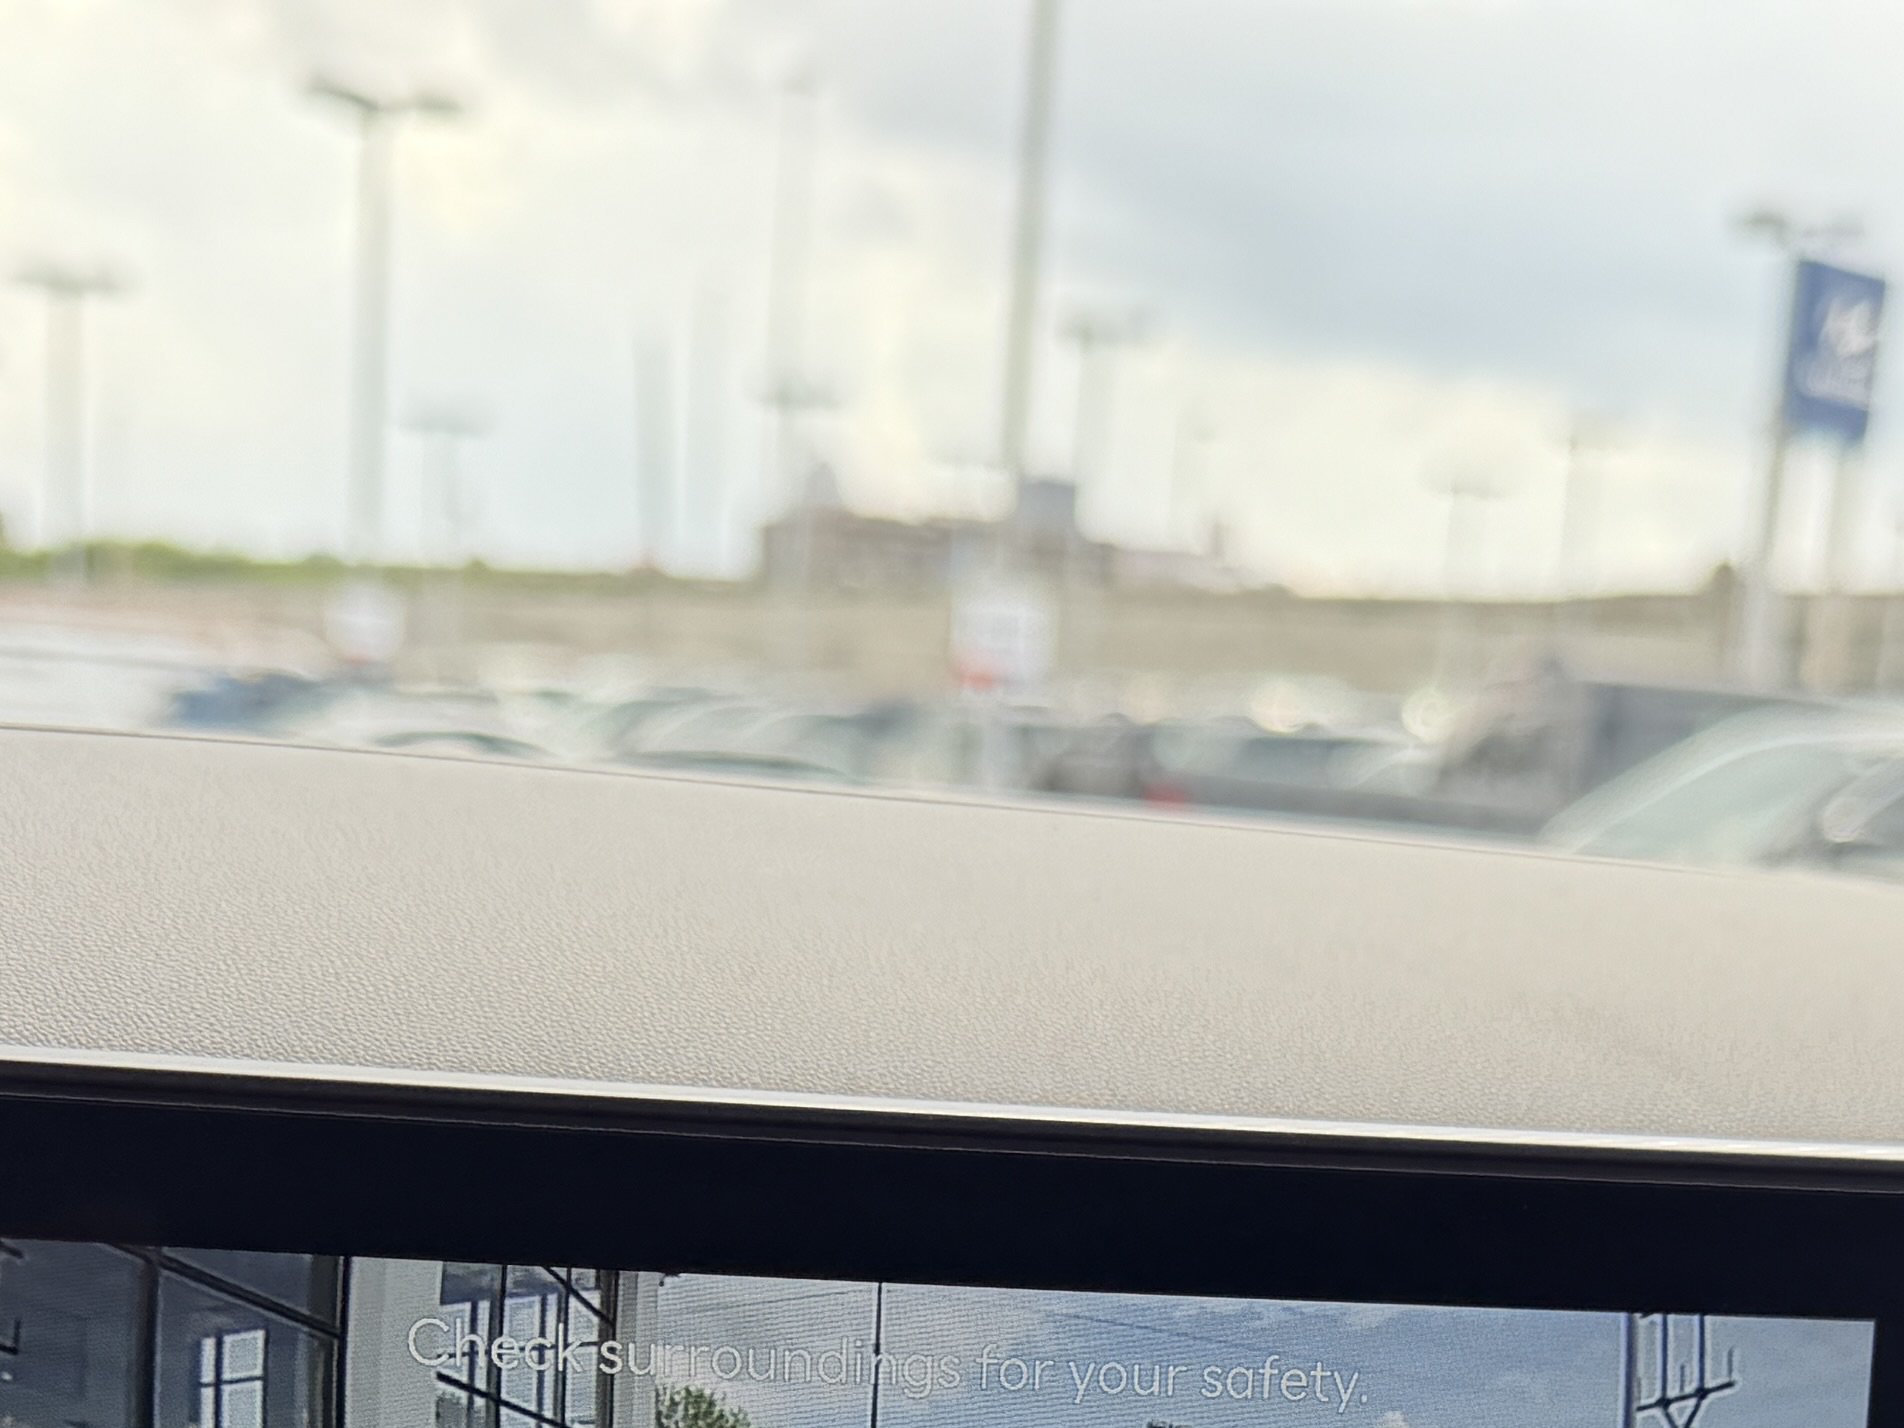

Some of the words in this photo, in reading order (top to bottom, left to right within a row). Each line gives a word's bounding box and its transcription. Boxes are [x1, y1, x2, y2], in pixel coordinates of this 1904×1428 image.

[407, 1318, 582, 1373] Check
[598, 1337, 962, 1399] surroundings
[976, 1344, 1053, 1392] for
[1068, 1358, 1188, 1402] your
[1200, 1354, 1368, 1411] safety.
